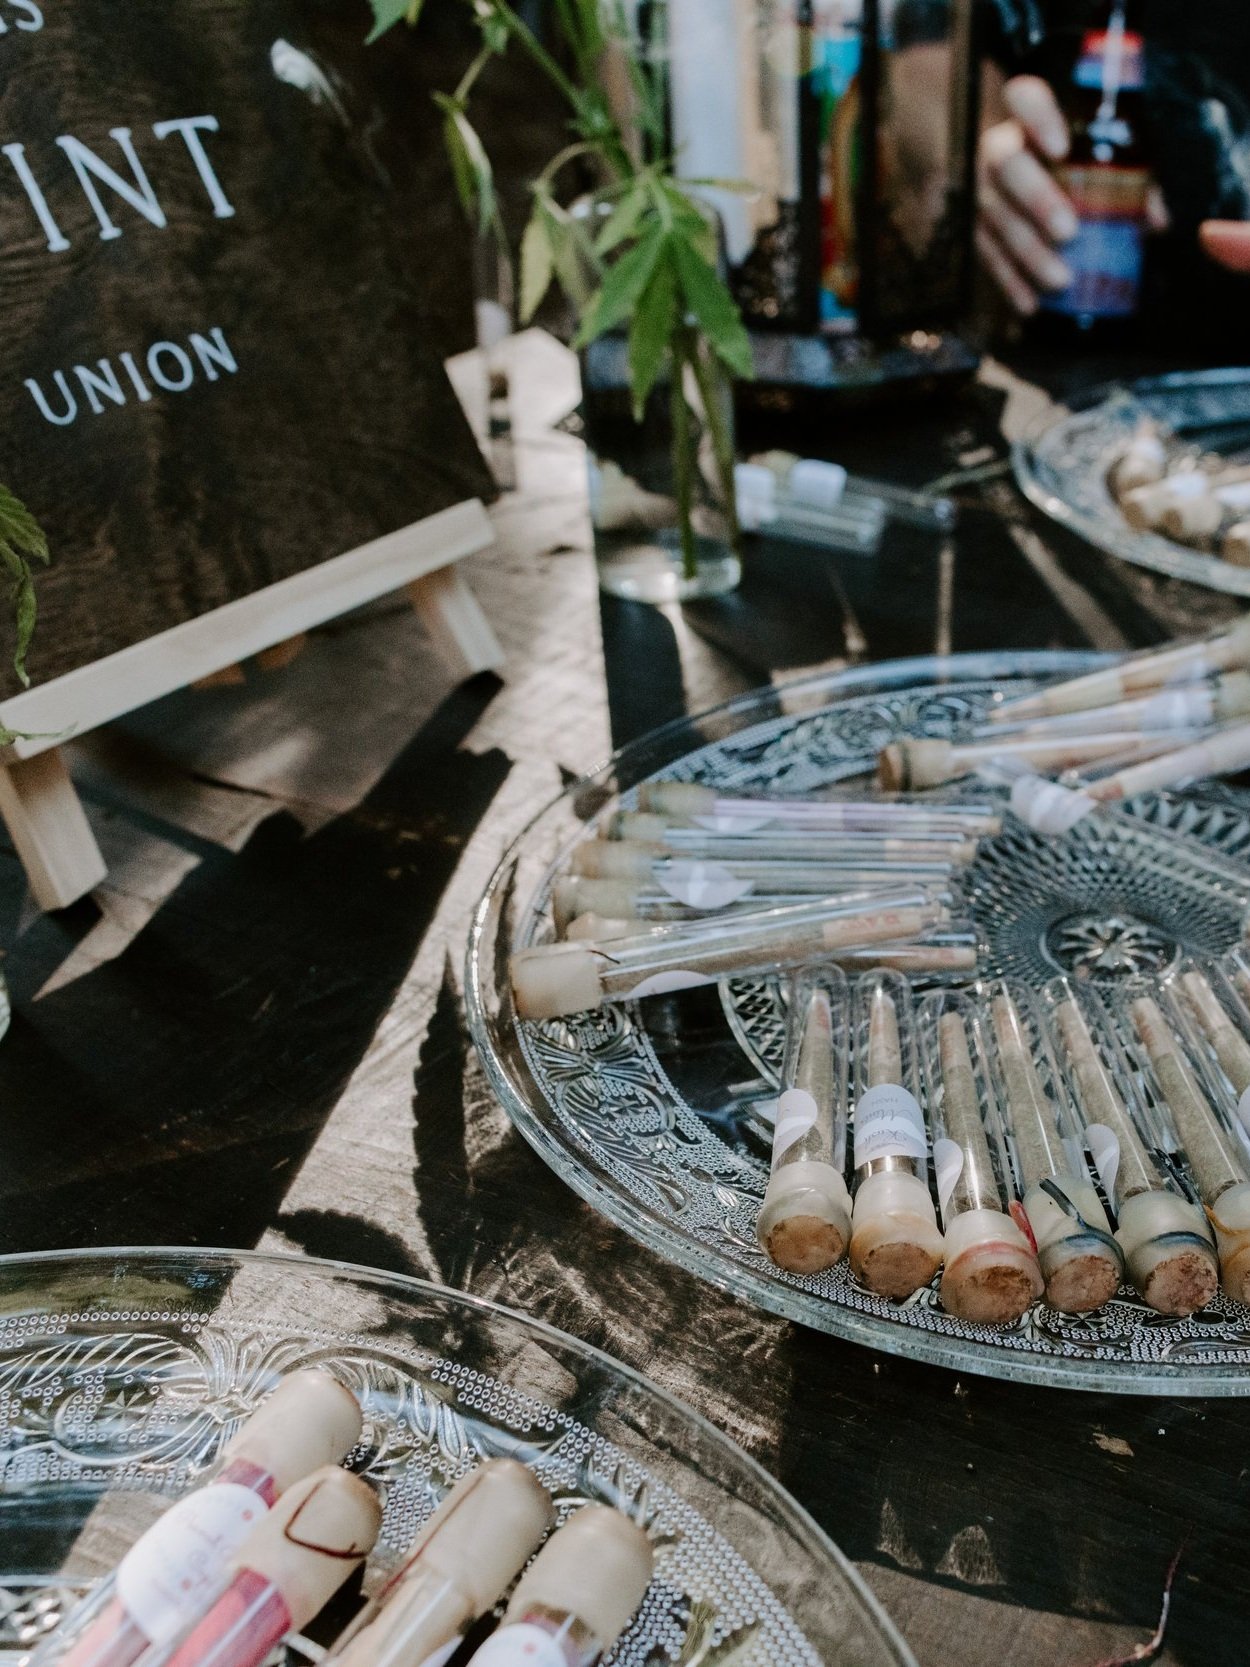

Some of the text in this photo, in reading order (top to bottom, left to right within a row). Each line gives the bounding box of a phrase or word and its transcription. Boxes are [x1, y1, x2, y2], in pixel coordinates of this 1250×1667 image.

[0, 0, 43, 33] S
[1, 115, 235, 253] INT
[24, 327, 238, 425] UNION
